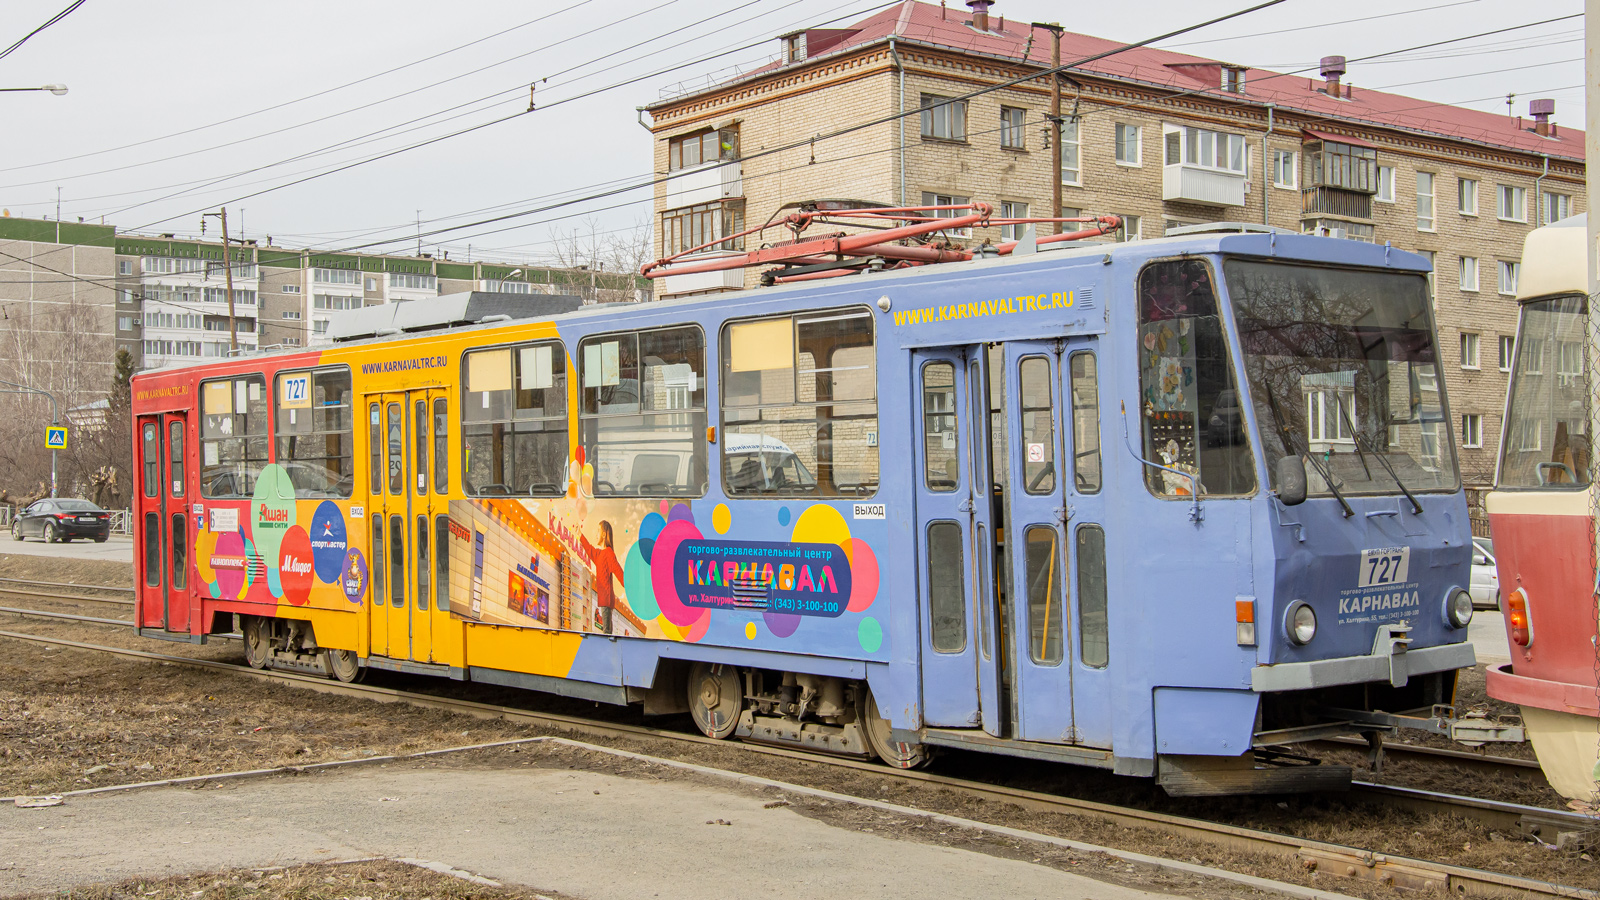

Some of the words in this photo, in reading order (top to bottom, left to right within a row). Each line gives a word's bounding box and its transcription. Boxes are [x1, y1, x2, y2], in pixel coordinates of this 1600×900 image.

[893, 291, 1074, 326] WWW.KARNAVALTRC.RU
[361, 355, 448, 375] WWW.KARNAVALTRC.RU
[136, 385, 189, 401] WWW.KARNAVALTRC.RU
[286, 379, 306, 400] 727
[210, 510, 216, 529] 6
[855, 505, 884, 517] ВЫХОД
[687, 545, 801, 558] торгово-развлекательный
[804, 550, 832, 562] центр
[688, 559, 839, 594] КАРНАВАЛ
[1368, 555, 1402, 585] 727
[1340, 582, 1405, 596] торгово-развлекательный
[1406, 582, 1419, 591] центр
[688, 594, 699, 604] ул.
[774, 597, 796, 611] (343)
[797, 599, 839, 613] 3-100-100
[1338, 590, 1420, 614] КАРНАВАЛ
